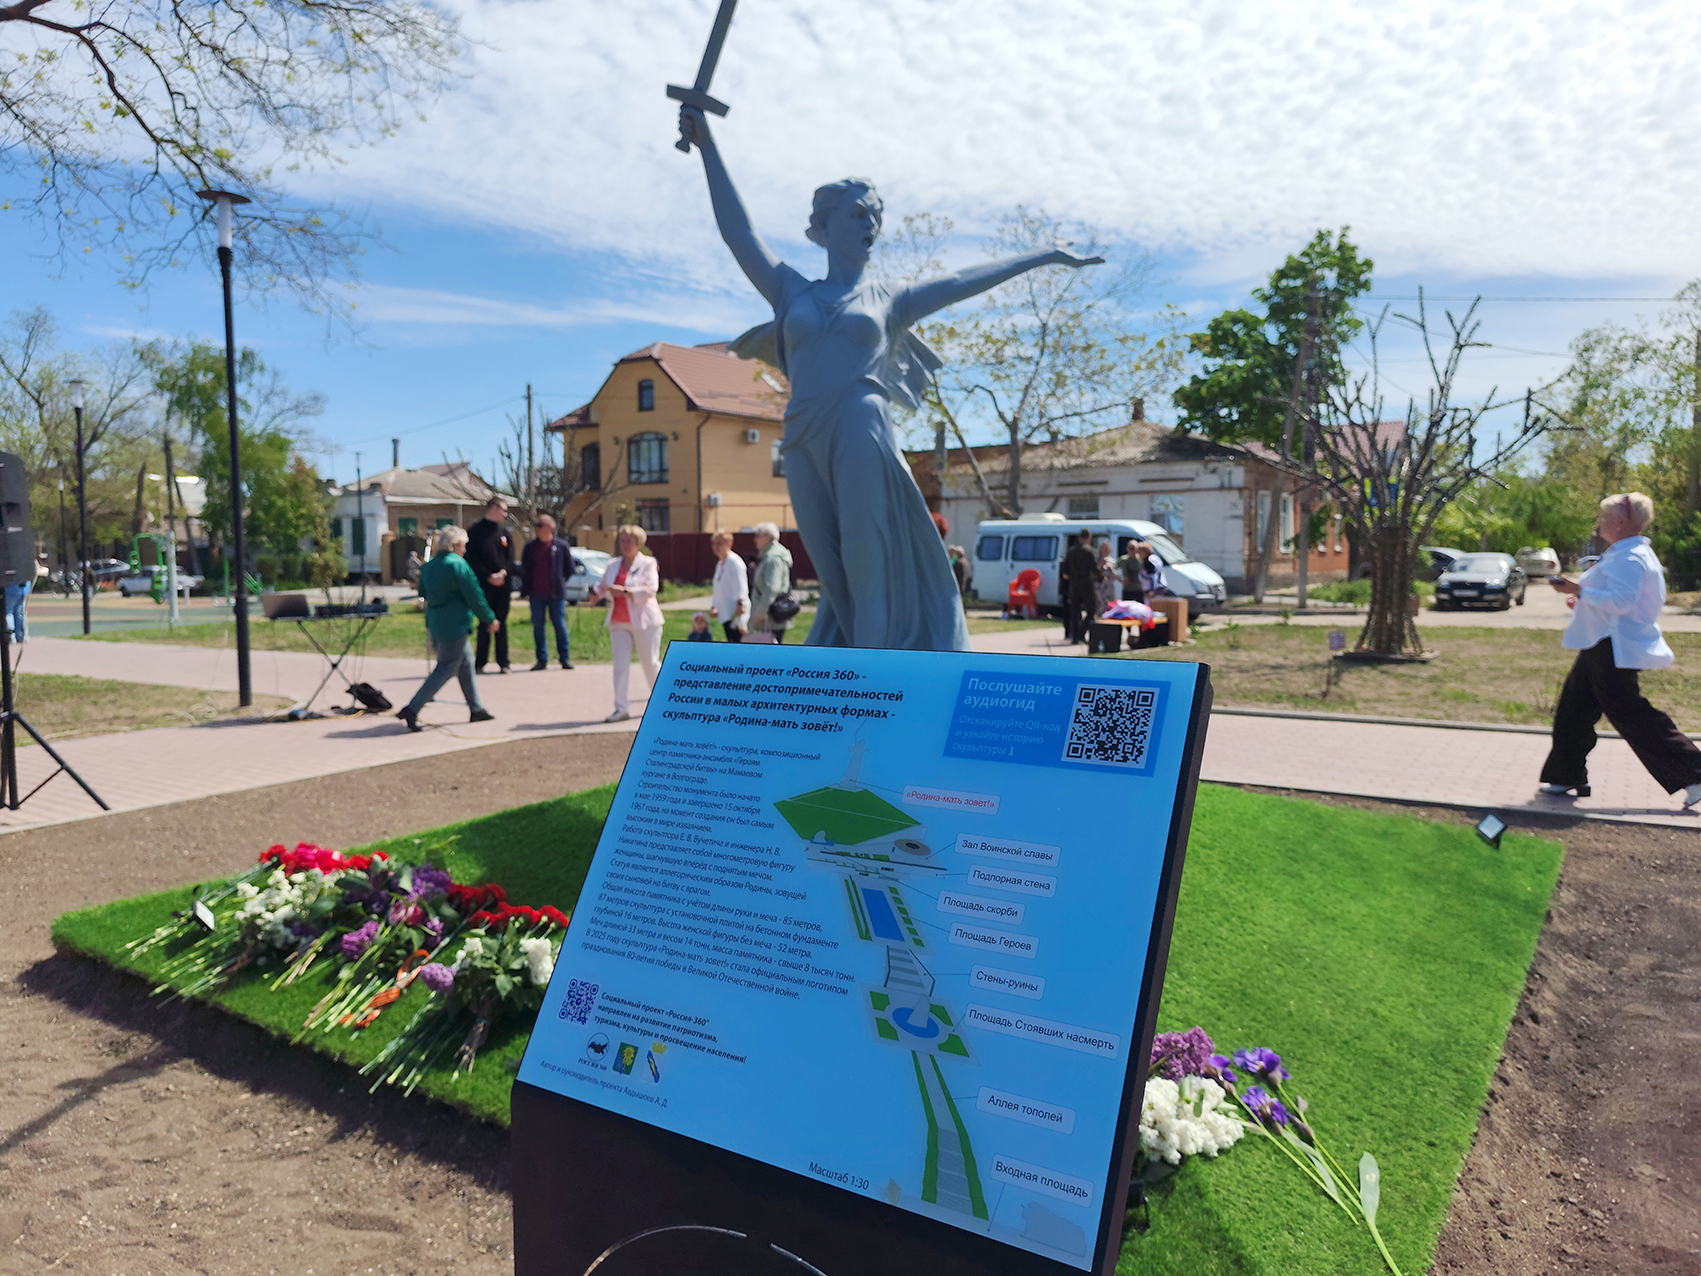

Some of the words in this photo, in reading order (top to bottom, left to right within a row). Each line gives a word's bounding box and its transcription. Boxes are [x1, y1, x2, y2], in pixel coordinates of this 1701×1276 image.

[679, 661, 744, 674] Социальный
[745, 666, 785, 677] проект
[785, 667, 831, 679] «Россия
[831, 669, 860, 681] 360»
[673, 679, 752, 691] представление
[751, 684, 903, 701] достопримечательностей
[967, 677, 1062, 695] Послушайте
[667, 692, 703, 704] России
[704, 697, 712, 705] в
[712, 698, 749, 708] малых
[750, 700, 838, 715] архитектурных
[840, 704, 889, 719] формах
[963, 695, 1035, 712] аудиогид
[662, 710, 721, 724] скульптура
[722, 713, 799, 729] «Родина-мать
[800, 720, 843, 733] зовёт!»
[958, 714, 1024, 729] Отсканируйте
[1025, 719, 1061, 733] QR-код
[951, 742, 1007, 755] скульптуры
[962, 730, 1000, 740] узнайте
[1001, 733, 1044, 745] историю
[906, 790, 962, 804] «Родина-мать
[963, 798, 995, 808] зовет!»
[961, 839, 979, 849] Зал
[979, 841, 1022, 856] Воинской
[1023, 850, 1053, 860] славы
[972, 869, 1022, 885] Подпорная
[1023, 879, 1050, 890] стена
[601, 881, 624, 892] Общая
[623, 886, 646, 897] высота
[646, 891, 681, 904] памятника
[685, 898, 711, 909] учётом
[709, 903, 735, 914] длины
[733, 908, 753, 918] руки
[758, 913, 778, 923] меча
[782, 915, 793, 926] 85
[943, 896, 984, 912] Площадь
[986, 905, 1018, 917] скорби
[593, 906, 623, 917] глубиной
[624, 911, 632, 920] 16
[657, 917, 682, 930] Высота
[681, 924, 712, 936] женской
[711, 929, 740, 943] фигуры
[739, 934, 753, 945] без
[753, 939, 772, 949] меча
[776, 942, 788, 953] 52
[597, 892, 607, 901] 87
[606, 896, 630, 906] метров
[629, 900, 666, 914] скульптура
[669, 909, 719, 924] установочной
[718, 918, 745, 930] плитой
[744, 924, 755, 932] на
[754, 923, 792, 940] бетонном
[791, 931, 839, 949] фундаменте
[590, 916, 603, 925] Меч
[602, 921, 627, 931] длиной
[627, 924, 637, 934] 33
[636, 928, 656, 938] метра
[662, 933, 683, 944] весом
[684, 936, 693, 945] 14
[711, 944, 733, 955] масса
[733, 949, 773, 964] памятника
[777, 958, 804, 971] свыше
[810, 965, 834, 978] тысяч
[954, 928, 997, 944] Площадь
[998, 936, 1031, 950] Героев
[581, 942, 626, 957] празднования
[625, 950, 655, 964] 80-летия
[655, 959, 682, 971] победы
[687, 964, 718, 980] Великой
[717, 971, 774, 993] Отечественной
[590, 929, 606, 940] 2025
[606, 934, 621, 945] году
[620, 937, 657, 952] скульптура
[729, 962, 750, 973] стала
[750, 966, 805, 985] официальным
[804, 979, 848, 996] логотипом
[976, 970, 1038, 991] Стены-руины
[601, 991, 641, 1009] Социальный
[641, 1004, 665, 1015] проект
[597, 1004, 632, 1019] направлен
[631, 1013, 640, 1021] на
[639, 1016, 671, 1030] развитие
[968, 1009, 1012, 1027] Площадь
[1015, 1019, 1064, 1039] Стоявших
[1066, 1032, 1114, 1050] насмерть
[622, 1023, 654, 1037] культуры
[659, 1034, 706, 1052] просвещение
[706, 1047, 747, 1064] населения!
[987, 1094, 1019, 1111] Аллея
[1022, 1105, 1063, 1123] тополей
[808, 1161, 849, 1184] Масштаб
[851, 1175, 869, 1190] 1:30
[995, 1160, 1038, 1182] Входная
[1040, 1176, 1088, 1198] площадь
